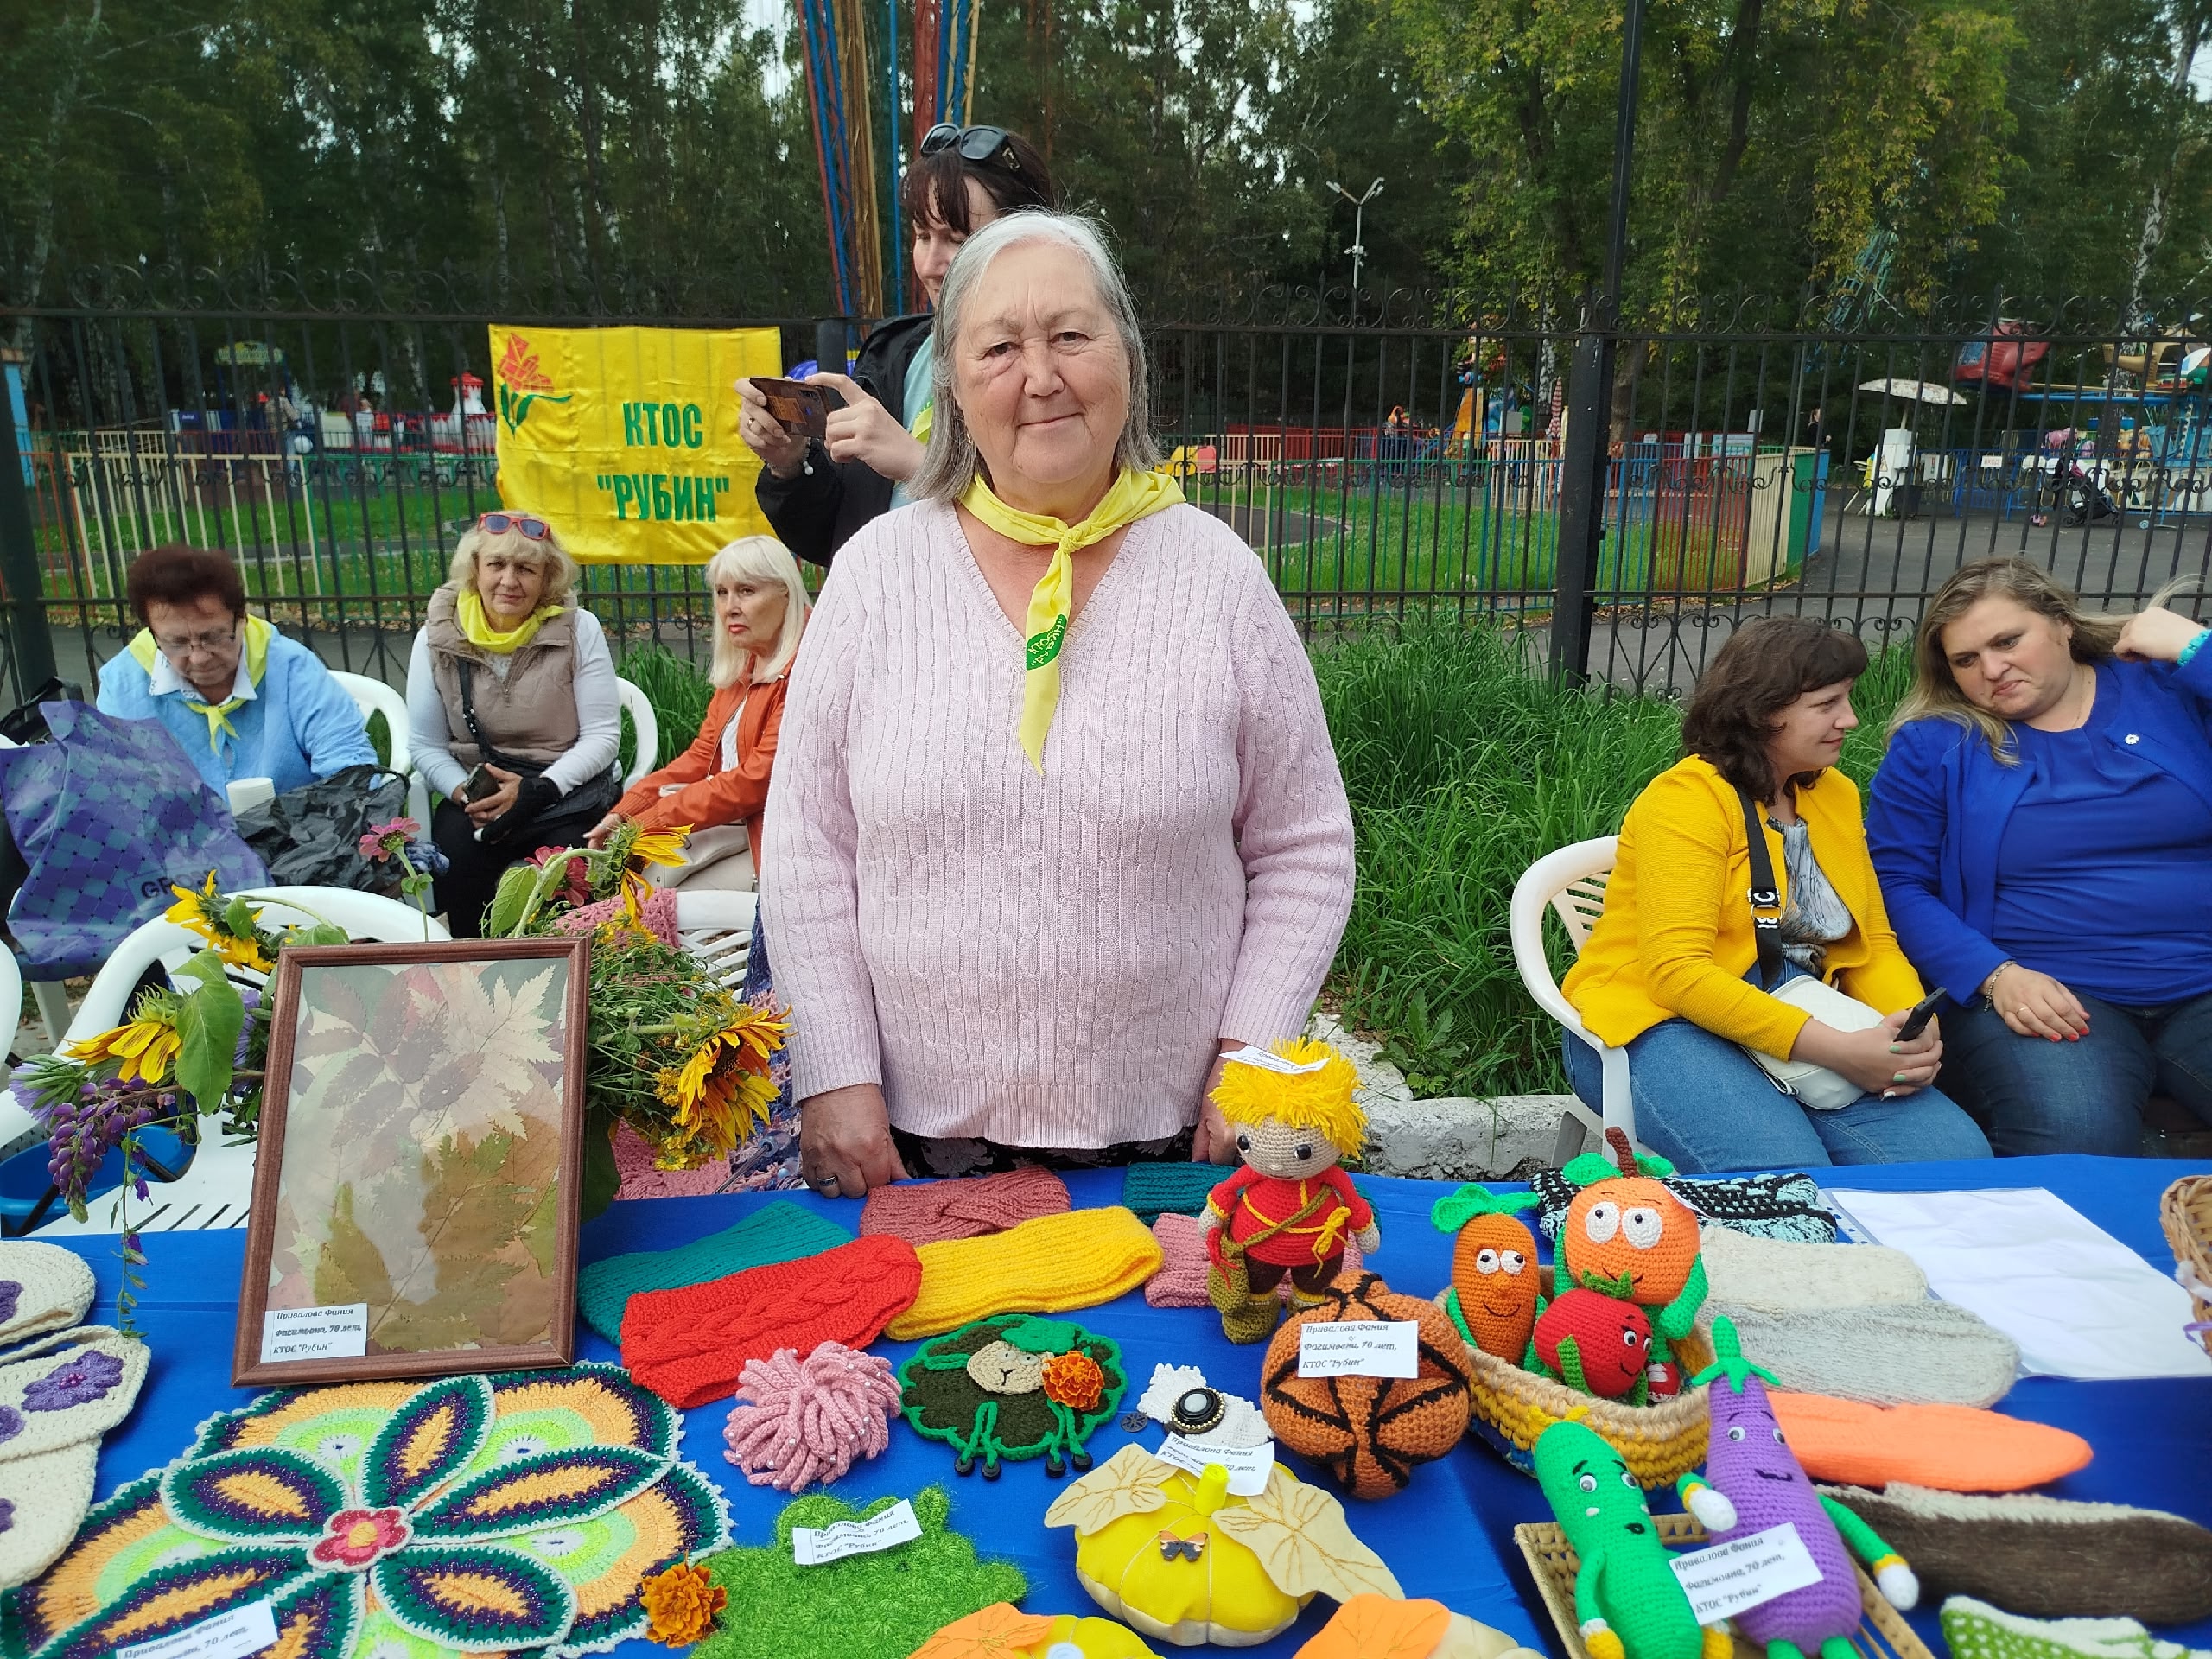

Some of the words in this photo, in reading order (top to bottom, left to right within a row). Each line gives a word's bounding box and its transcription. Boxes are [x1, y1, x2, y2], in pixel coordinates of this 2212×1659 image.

[623, 403, 702, 448] КТОС
[597, 474, 729, 522] "РУБИН"
[1028, 631, 1053, 655] КТОС
[276, 1310, 322, 1320] Привалова
[1306, 1325, 1356, 1334] Привалова
[273, 1345, 296, 1354] КТОС
[298, 1342, 333, 1353] "Рубин"
[1304, 1341, 1359, 1351] Фагимовна,
[1374, 1343, 1397, 1351] лет,
[1302, 1359, 1327, 1369] КТОС
[1329, 1358, 1365, 1369] "Рубин"
[865, 1510, 895, 1527] Фания
[874, 1527, 885, 1535] 70
[887, 1520, 909, 1531] лет,
[816, 1545, 843, 1559] КТОС
[844, 1540, 882, 1548] "Рубин"
[1675, 1547, 1729, 1571] Привалова
[1731, 1537, 1764, 1553] Фания
[1685, 1567, 1745, 1591] Фагимовна,
[1745, 1560, 1760, 1573] 70
[1761, 1553, 1785, 1568] лет,
[1696, 1598, 1724, 1614] КТОС
[1723, 1584, 1762, 1605] "Рубин"
[124, 1633, 192, 1658] Привалова
[195, 1615, 234, 1634] Фания
[204, 1637, 219, 1649] 70
[221, 1626, 248, 1643] лет,
